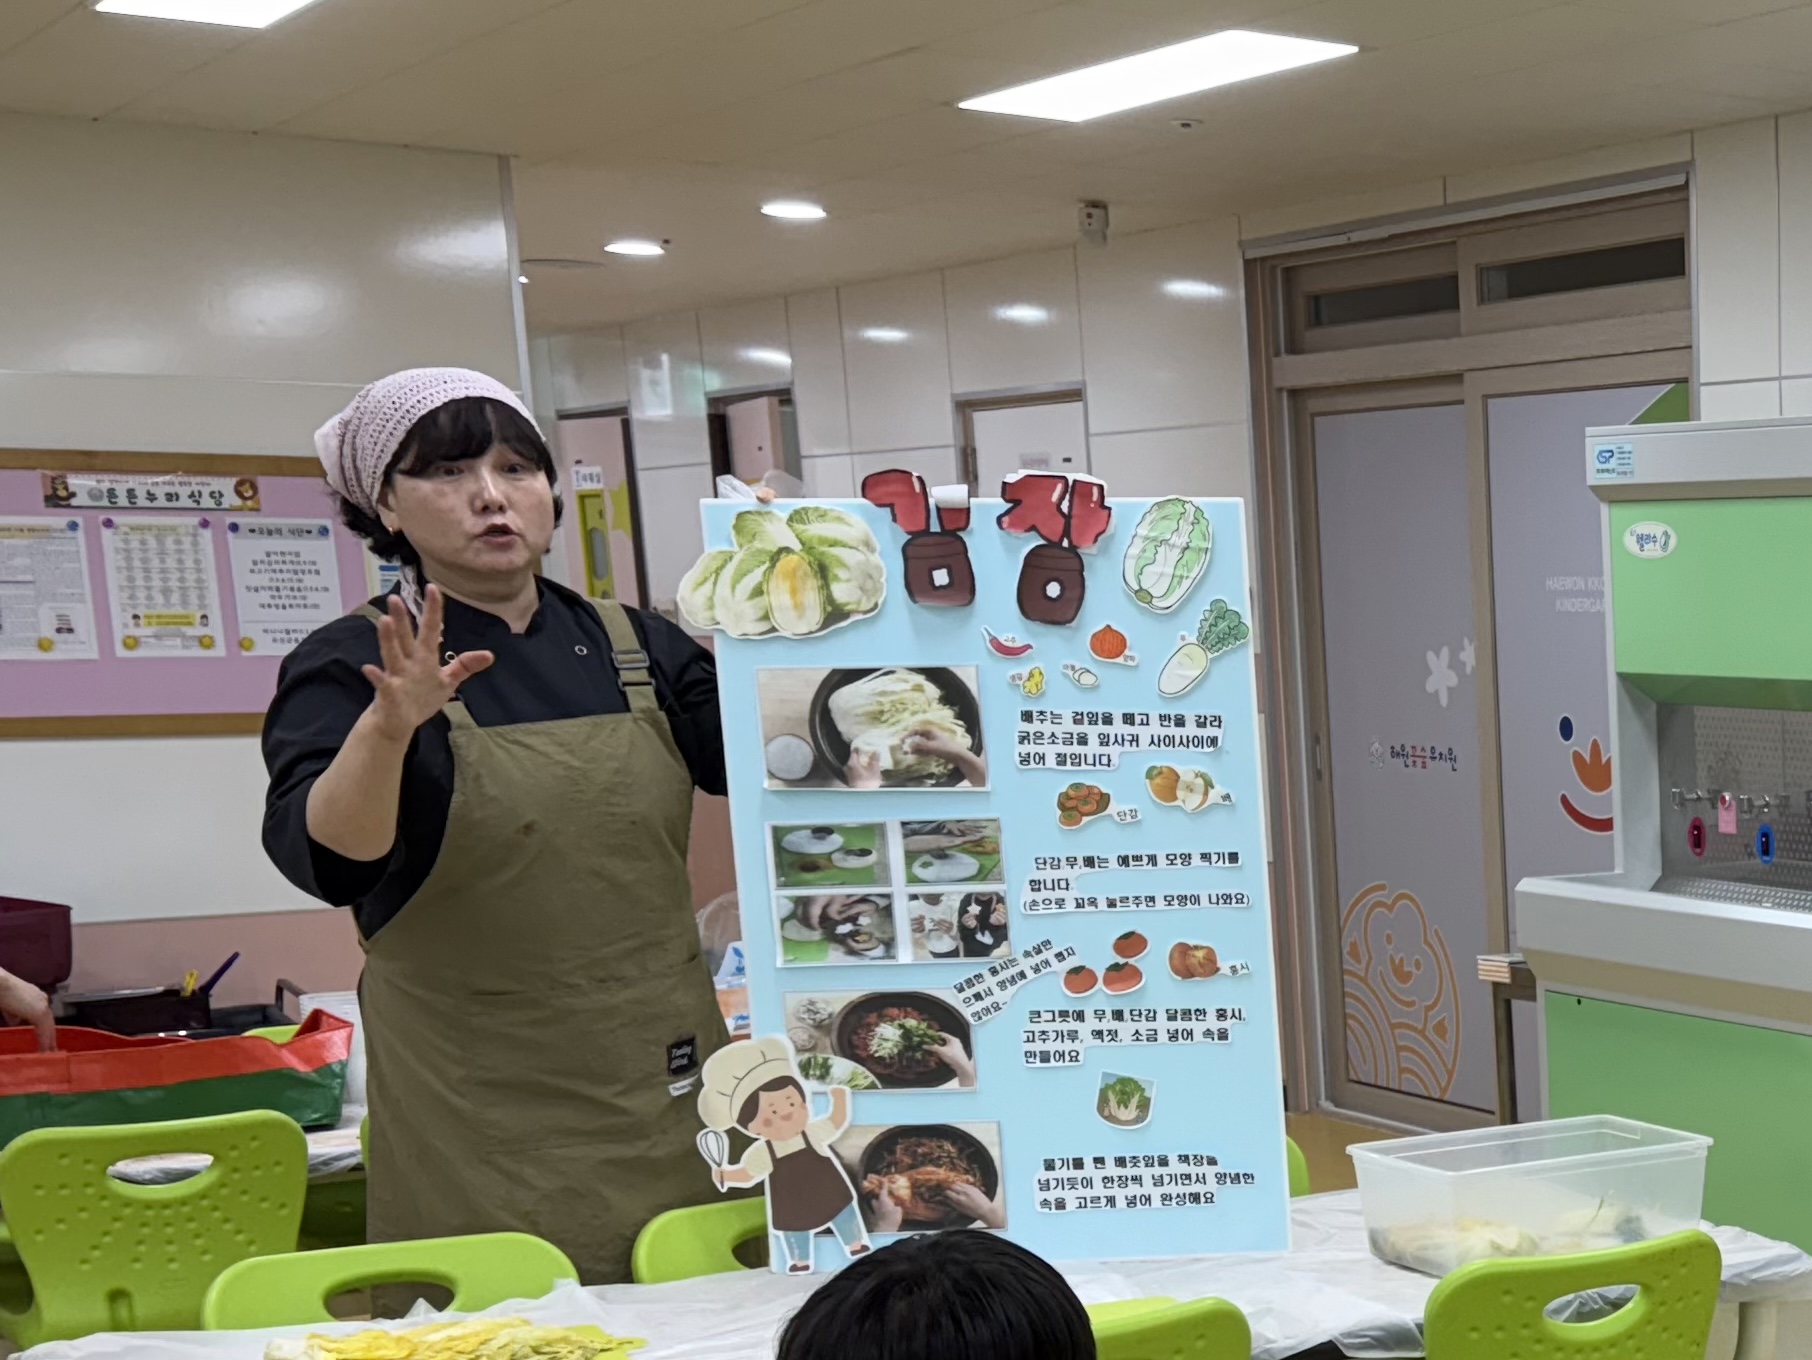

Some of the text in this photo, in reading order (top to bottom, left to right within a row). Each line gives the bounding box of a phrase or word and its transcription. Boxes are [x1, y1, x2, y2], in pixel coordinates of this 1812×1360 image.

[1020, 709, 1222, 729] 배추는 겉잎을 떼고 반을 갈라
[1018, 730, 1219, 749] 굵은소금을 잎사귀 사이사이에
[1018, 752, 1115, 768] 넣어 절입니다.
[1116, 808, 1138, 821] 단감
[1117, 853, 1158, 868] 예쁘게
[1165, 852, 1192, 867] 모양
[1199, 851, 1239, 865] 찍기를
[1028, 878, 1072, 893] 합니다.
[1023, 896, 1066, 912] (손으로
[1163, 893, 1201, 907] 모양이
[1208, 891, 1250, 907] 나와요)
[953, 972, 985, 994] 달콤한
[987, 957, 1020, 977] 홍시는
[995, 969, 1028, 991] 양념에
[1030, 958, 1052, 975] 넣어
[1228, 961, 1250, 976] 홍시
[1028, 1007, 1247, 1023] 큰그릇에 무,배,단감 달콤한 홍시,
[1023, 1026, 1229, 1044] 고추가루, 액젓, 소금 넣어 속을
[1024, 1049, 1081, 1064] 만들어요
[1043, 1157, 1085, 1172] 물기를
[1114, 1154, 1169, 1169] 배춧잎을
[1038, 1171, 1255, 1192] 넘기듯이 한장씩 넘기면서 양념한
[1039, 1191, 1215, 1211] 속을 고르게 넣어 완성해요
